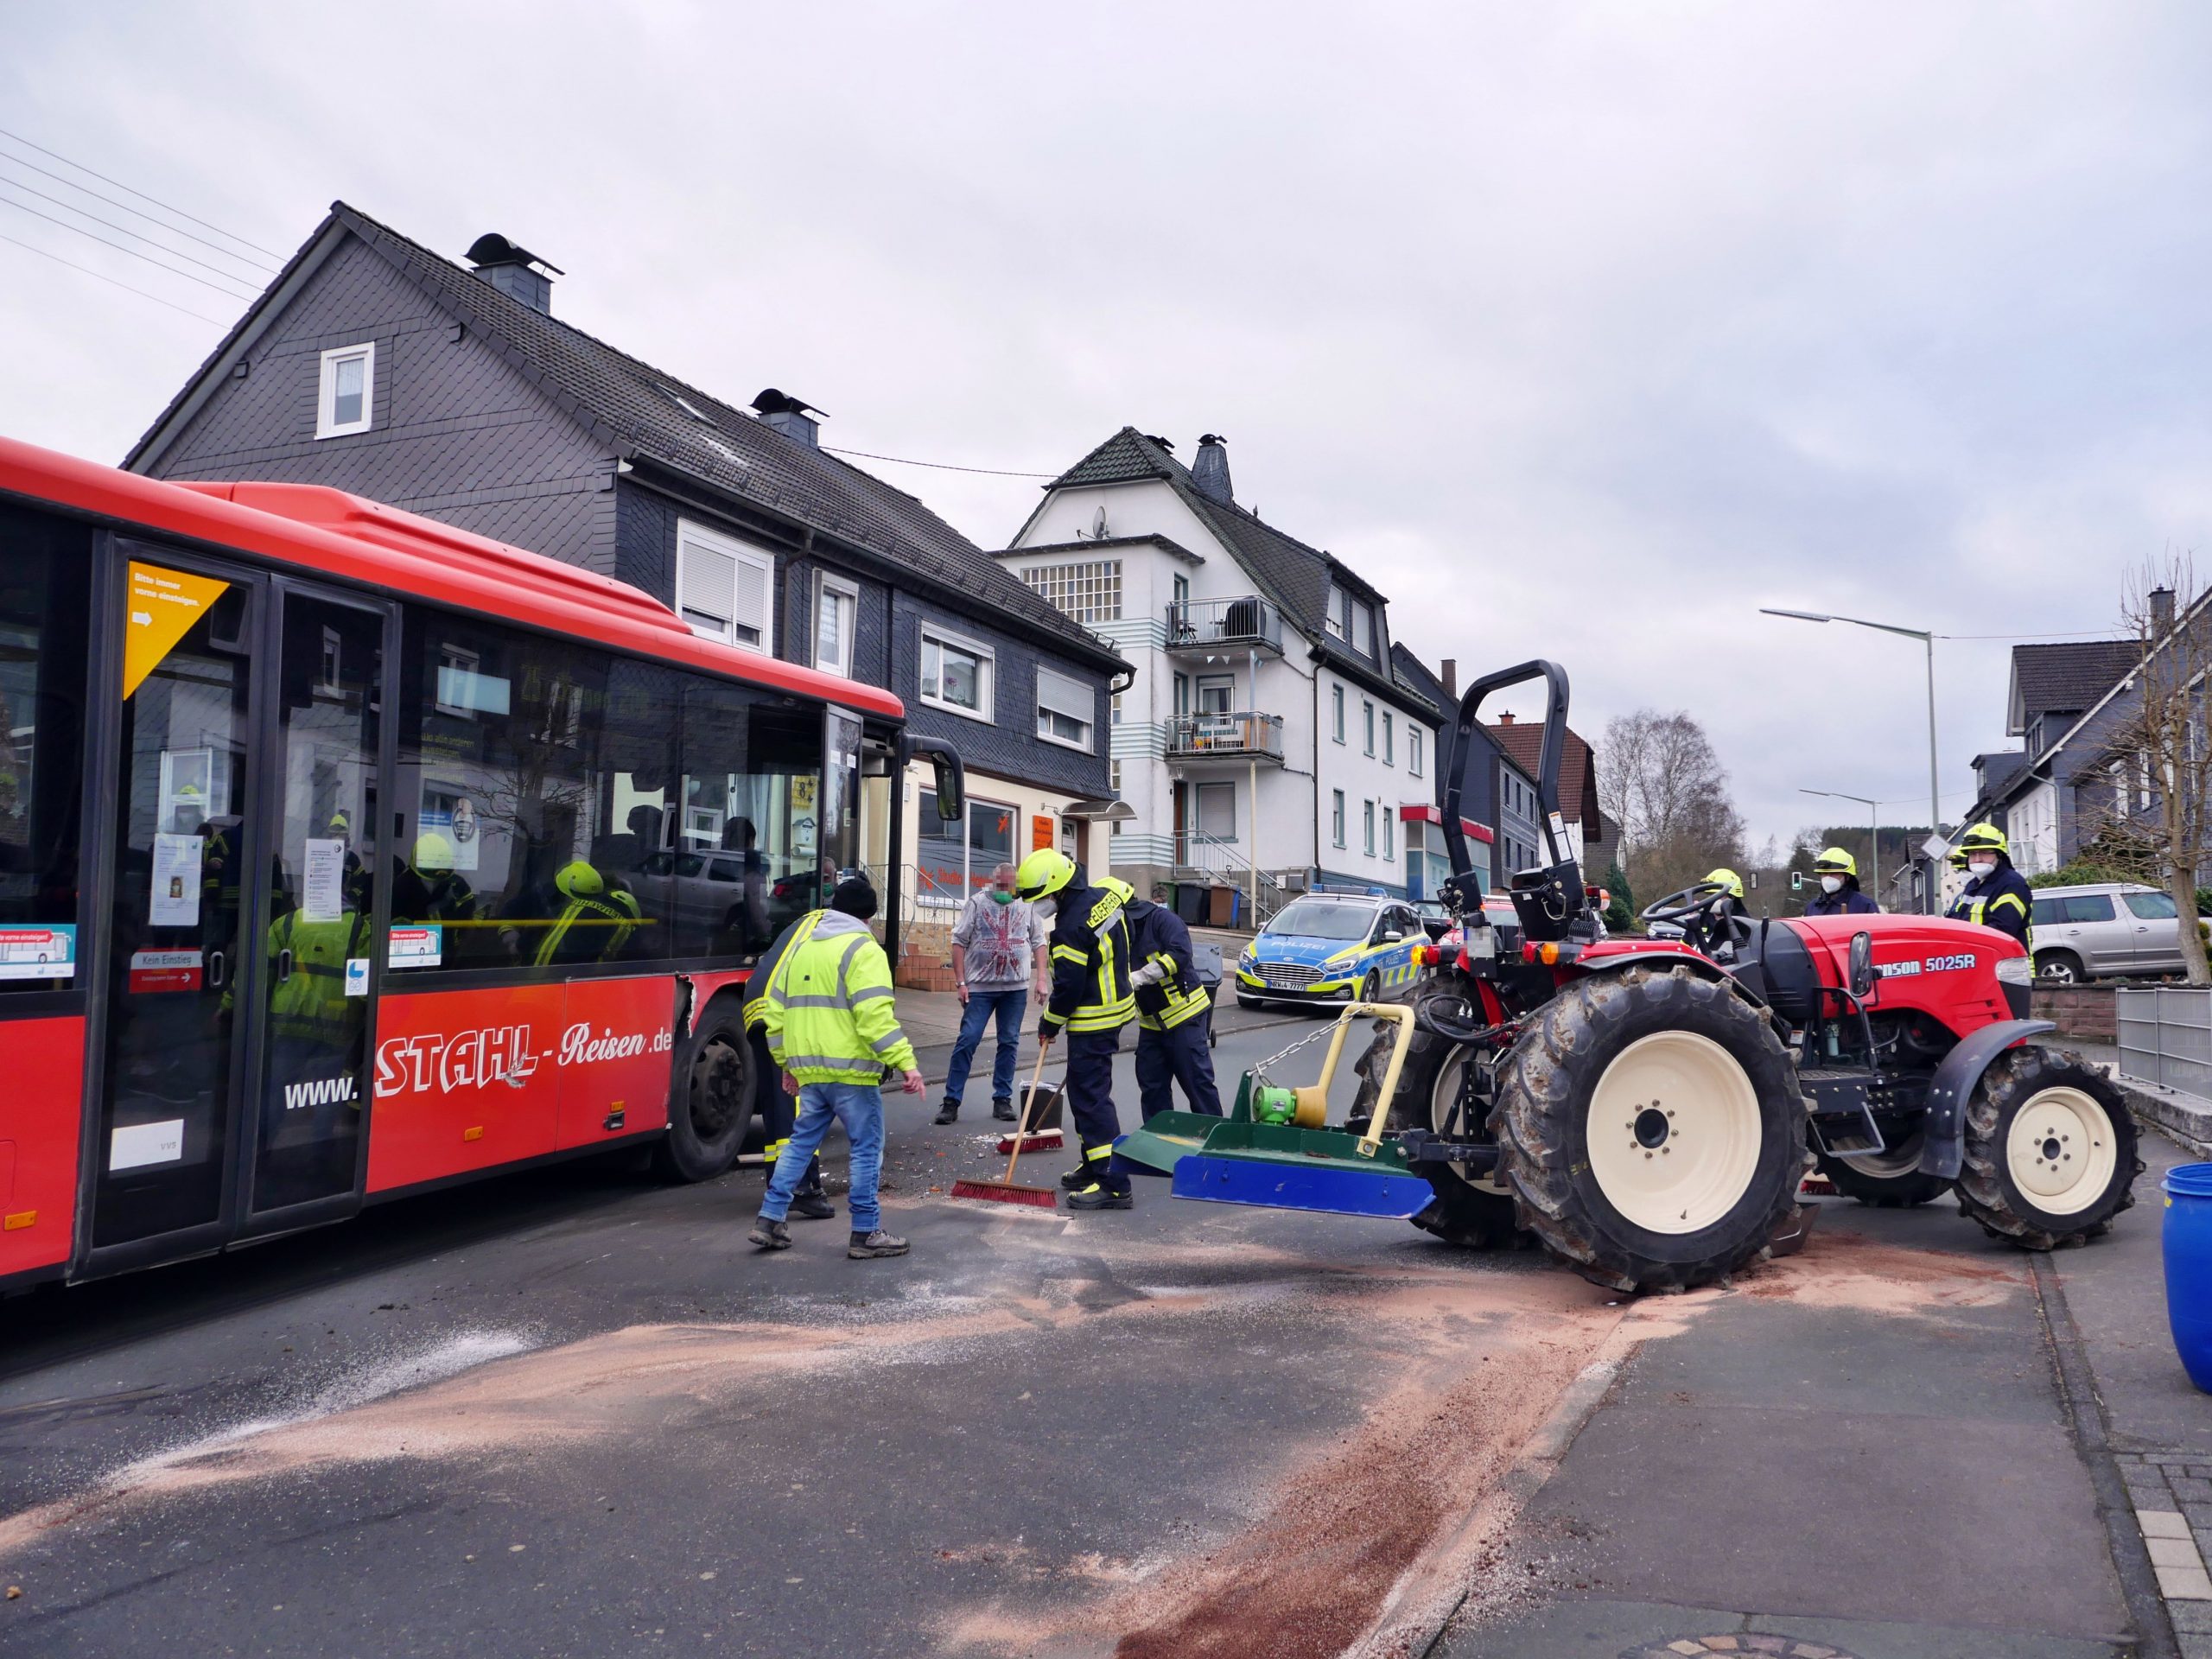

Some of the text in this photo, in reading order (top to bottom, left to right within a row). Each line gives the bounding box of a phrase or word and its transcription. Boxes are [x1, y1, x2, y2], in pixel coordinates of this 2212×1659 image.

[135, 572, 181, 589] Bitte immer
[135, 588, 156, 598] vorne
[800, 782, 805, 798] 8
[1087, 893, 1122, 927] FEUERWEHR
[1271, 940, 1326, 950] POLIZEI
[143, 954, 192, 967] Kein Einstieg
[1925, 954, 1976, 972] 5025R
[284, 1076, 358, 1109] www.
